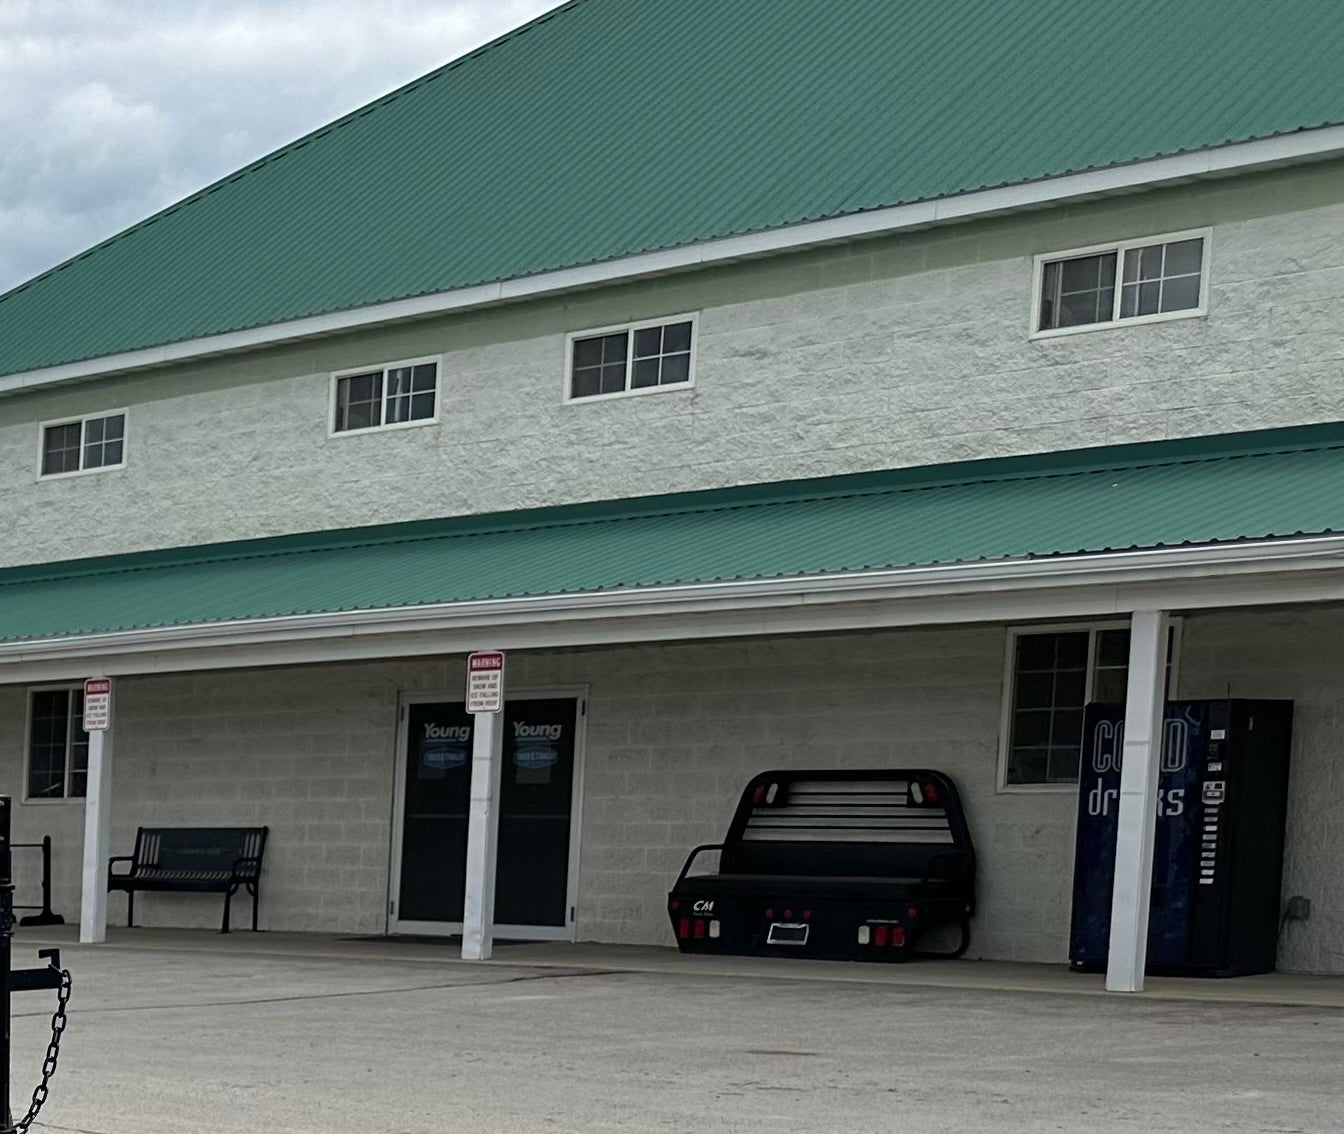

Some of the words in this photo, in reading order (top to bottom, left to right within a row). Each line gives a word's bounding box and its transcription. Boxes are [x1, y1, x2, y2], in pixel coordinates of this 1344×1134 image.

[424, 722, 471, 742] Young
[512, 721, 562, 741] Young
[1092, 718, 1188, 773] COD
[693, 900, 714, 911] CM
